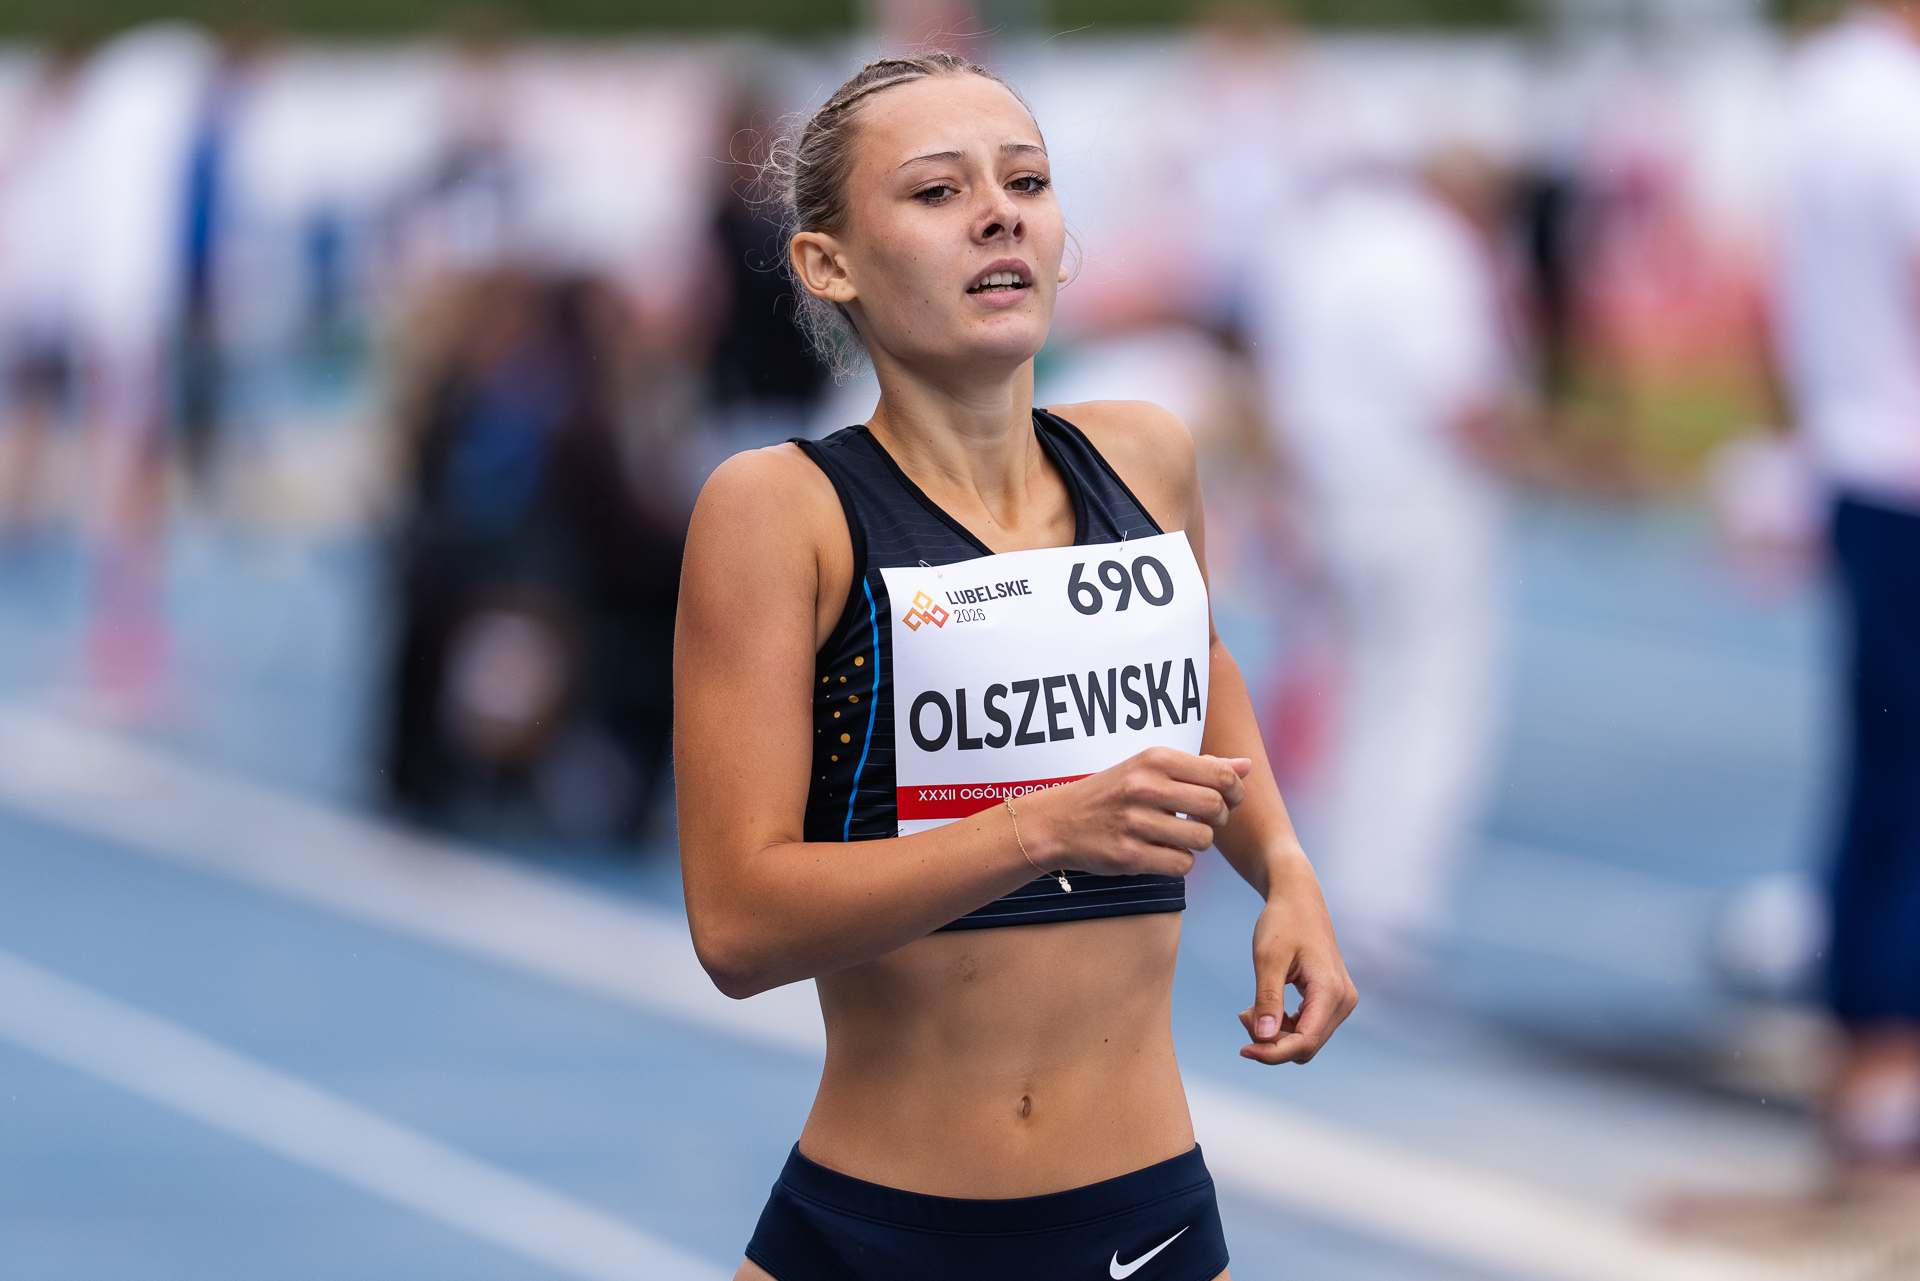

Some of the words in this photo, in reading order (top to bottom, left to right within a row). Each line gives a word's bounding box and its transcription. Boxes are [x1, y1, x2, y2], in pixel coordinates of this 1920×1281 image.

[945, 579, 1032, 605] LUBELSKIE
[1067, 555, 1174, 615] 690
[953, 608, 986, 623] 2026
[909, 657, 1202, 752] OLSZEWSKA
[918, 789, 956, 801] XXXII
